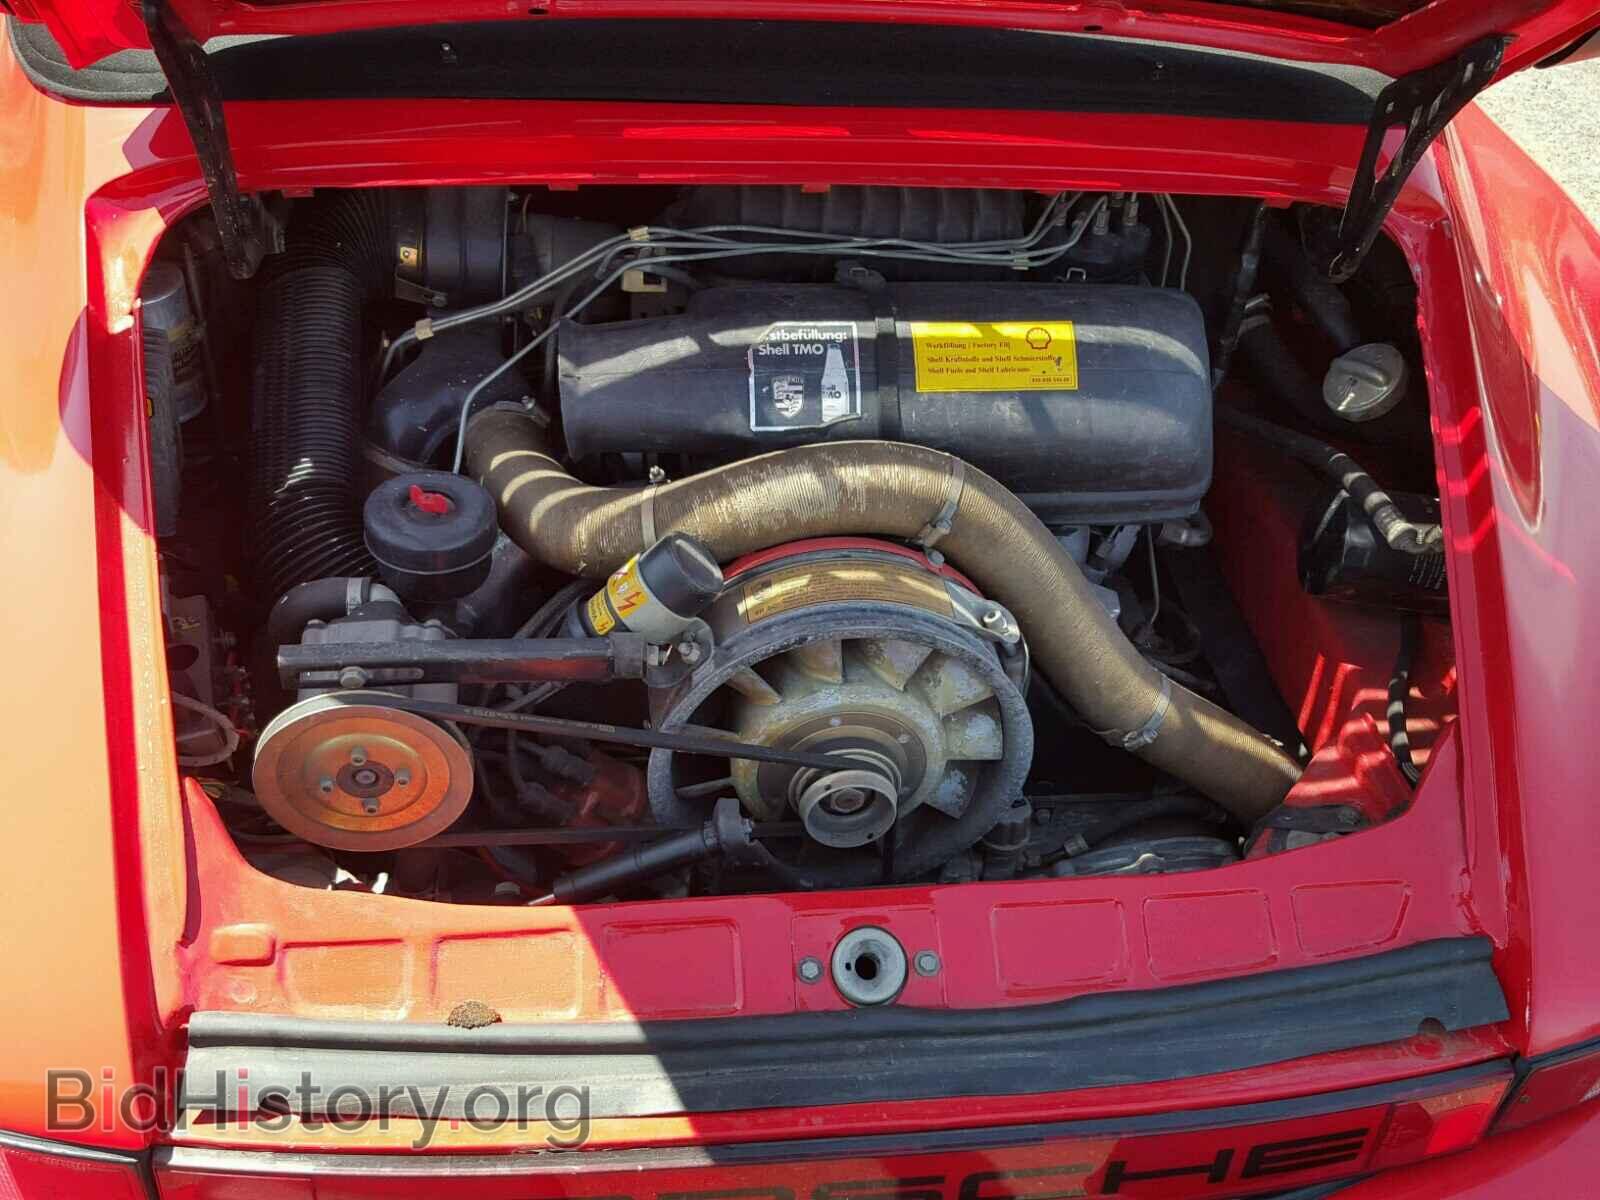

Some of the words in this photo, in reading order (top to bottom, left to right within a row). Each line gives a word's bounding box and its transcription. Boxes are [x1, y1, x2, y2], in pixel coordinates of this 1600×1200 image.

[766, 328, 848, 343] stbefüllung:
[758, 343, 790, 355] Shell
[792, 343, 824, 355] TMO
